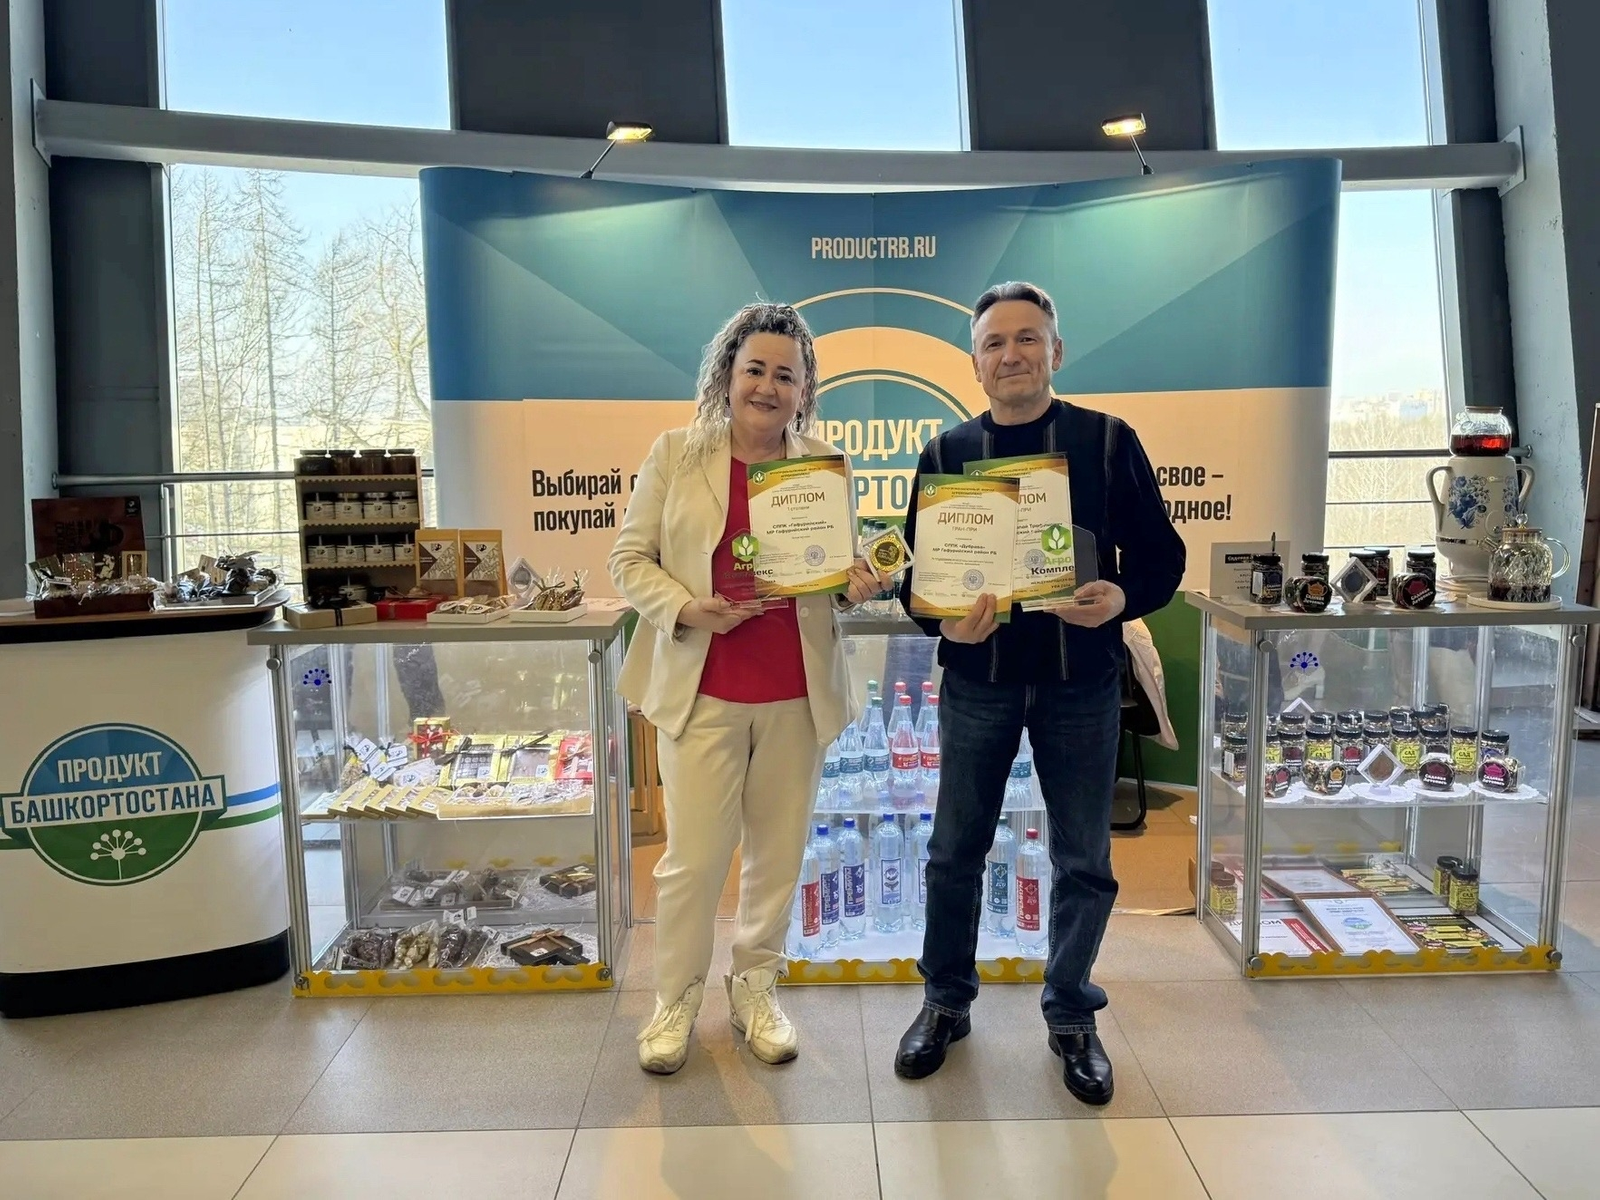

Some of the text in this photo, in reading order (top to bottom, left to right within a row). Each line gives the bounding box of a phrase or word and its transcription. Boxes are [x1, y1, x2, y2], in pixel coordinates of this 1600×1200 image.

[811, 236, 936, 259] PRODUCTRB.RU
[532, 468, 621, 500] Выбирай
[1156, 466, 1205, 486] свое
[771, 492, 825, 507] ДИПЛОМ
[534, 502, 615, 535] покупай
[937, 512, 994, 525] ДИПЛОМ
[733, 563, 753, 571] Агр
[1045, 556, 1071, 565] Агро
[57, 751, 162, 783] ПРОДУКТ
[11, 783, 216, 824] БАШКОРТОСТАНА
